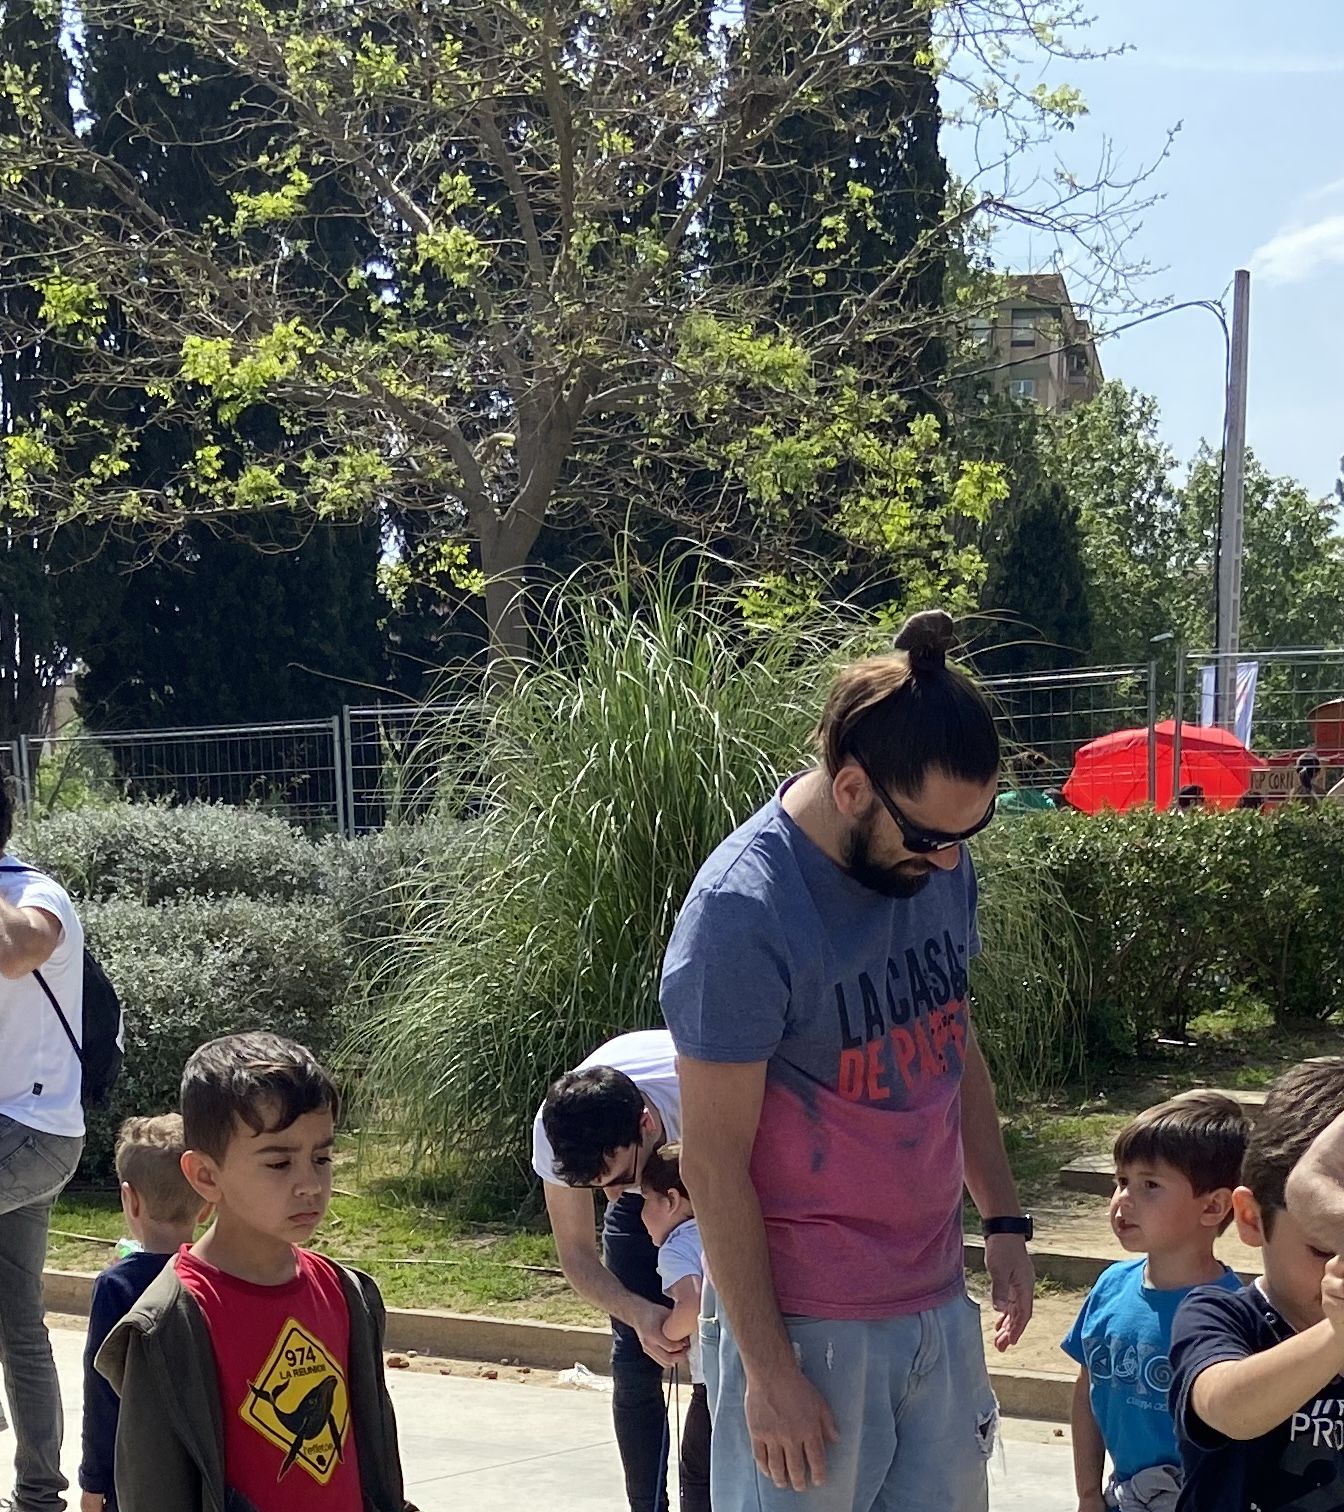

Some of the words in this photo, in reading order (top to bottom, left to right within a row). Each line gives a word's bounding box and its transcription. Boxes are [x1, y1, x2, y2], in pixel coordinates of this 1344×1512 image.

[835, 971, 885, 1049] LA
[886, 930, 968, 1025] CASA
[831, 1040, 891, 1101] DE
[279, 1371, 292, 1380] LA
[285, 1345, 316, 1367] 974
